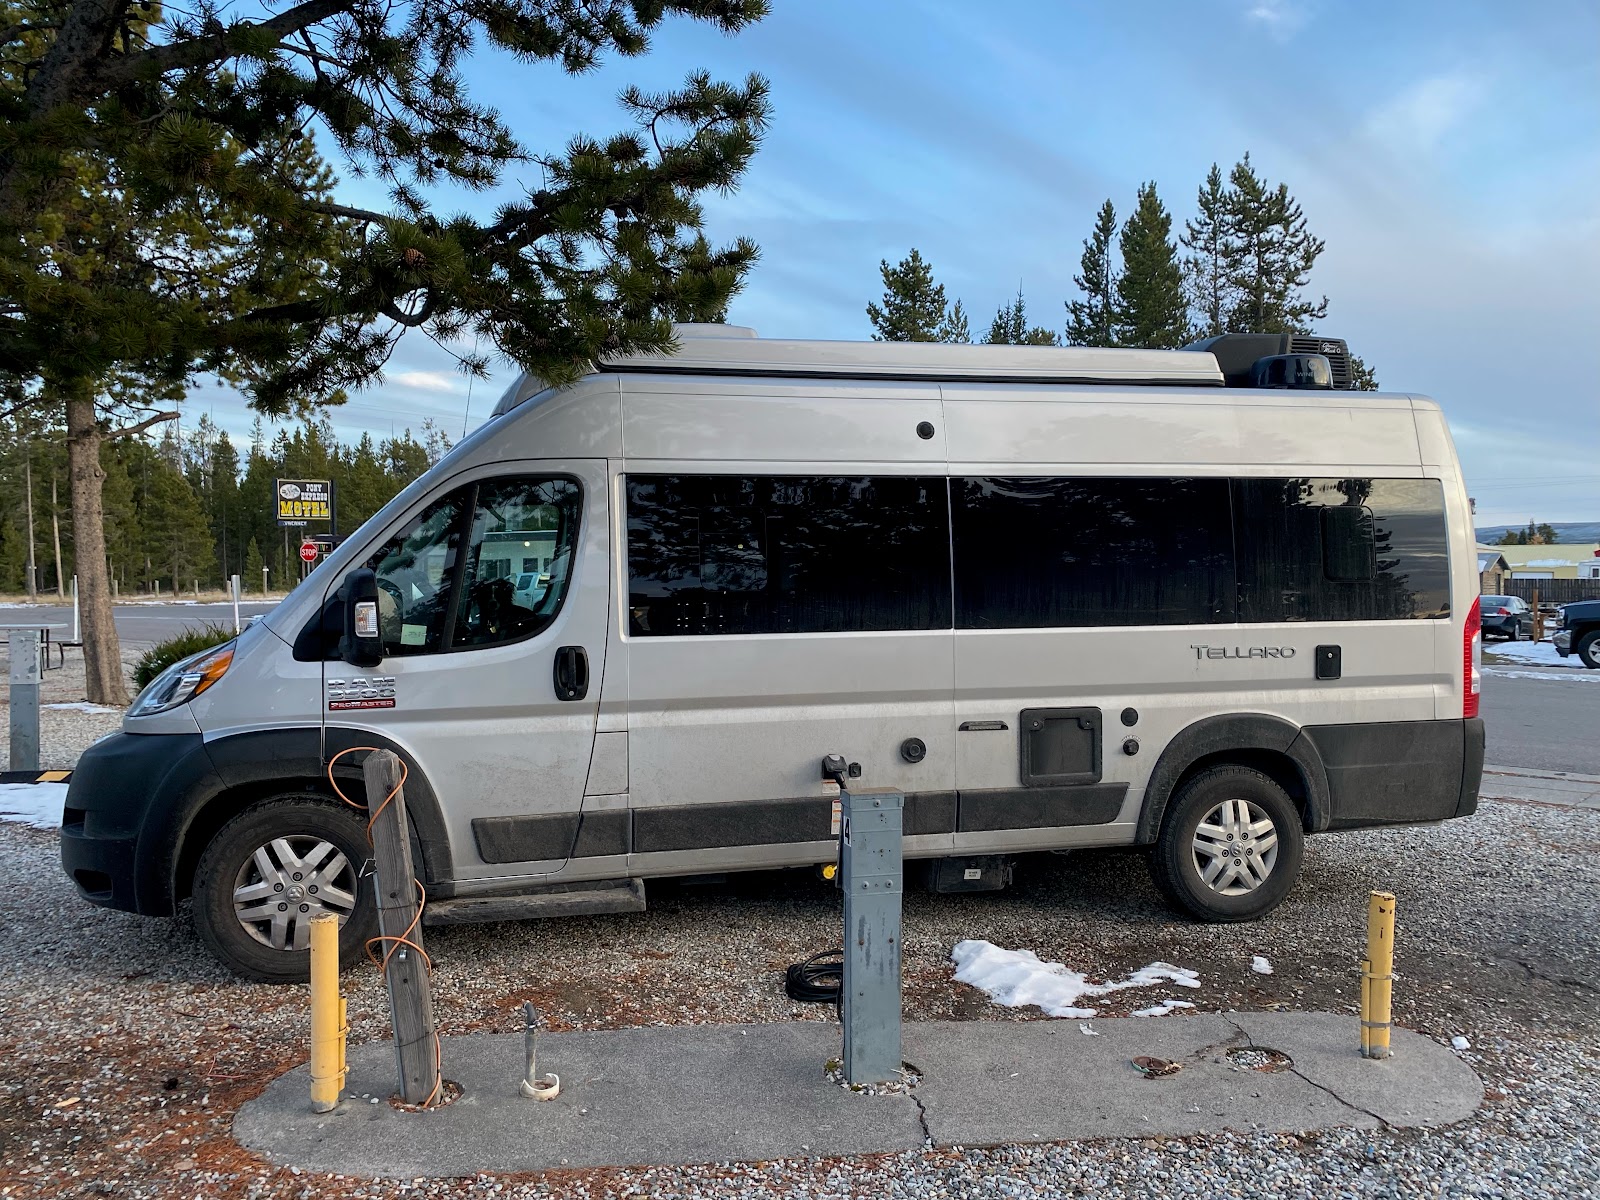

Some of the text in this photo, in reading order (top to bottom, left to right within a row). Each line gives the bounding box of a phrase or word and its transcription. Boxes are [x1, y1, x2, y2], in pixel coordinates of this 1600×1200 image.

[305, 483, 322, 492] PONY
[300, 492, 328, 501] EXPRESS
[280, 500, 329, 517] MOTEL
[301, 548, 317, 557] STOP
[1190, 644, 1297, 660] TELLARO
[327, 676, 396, 689] RAM
[330, 700, 394, 708] PROMASTER
[844, 817, 850, 844] 4
